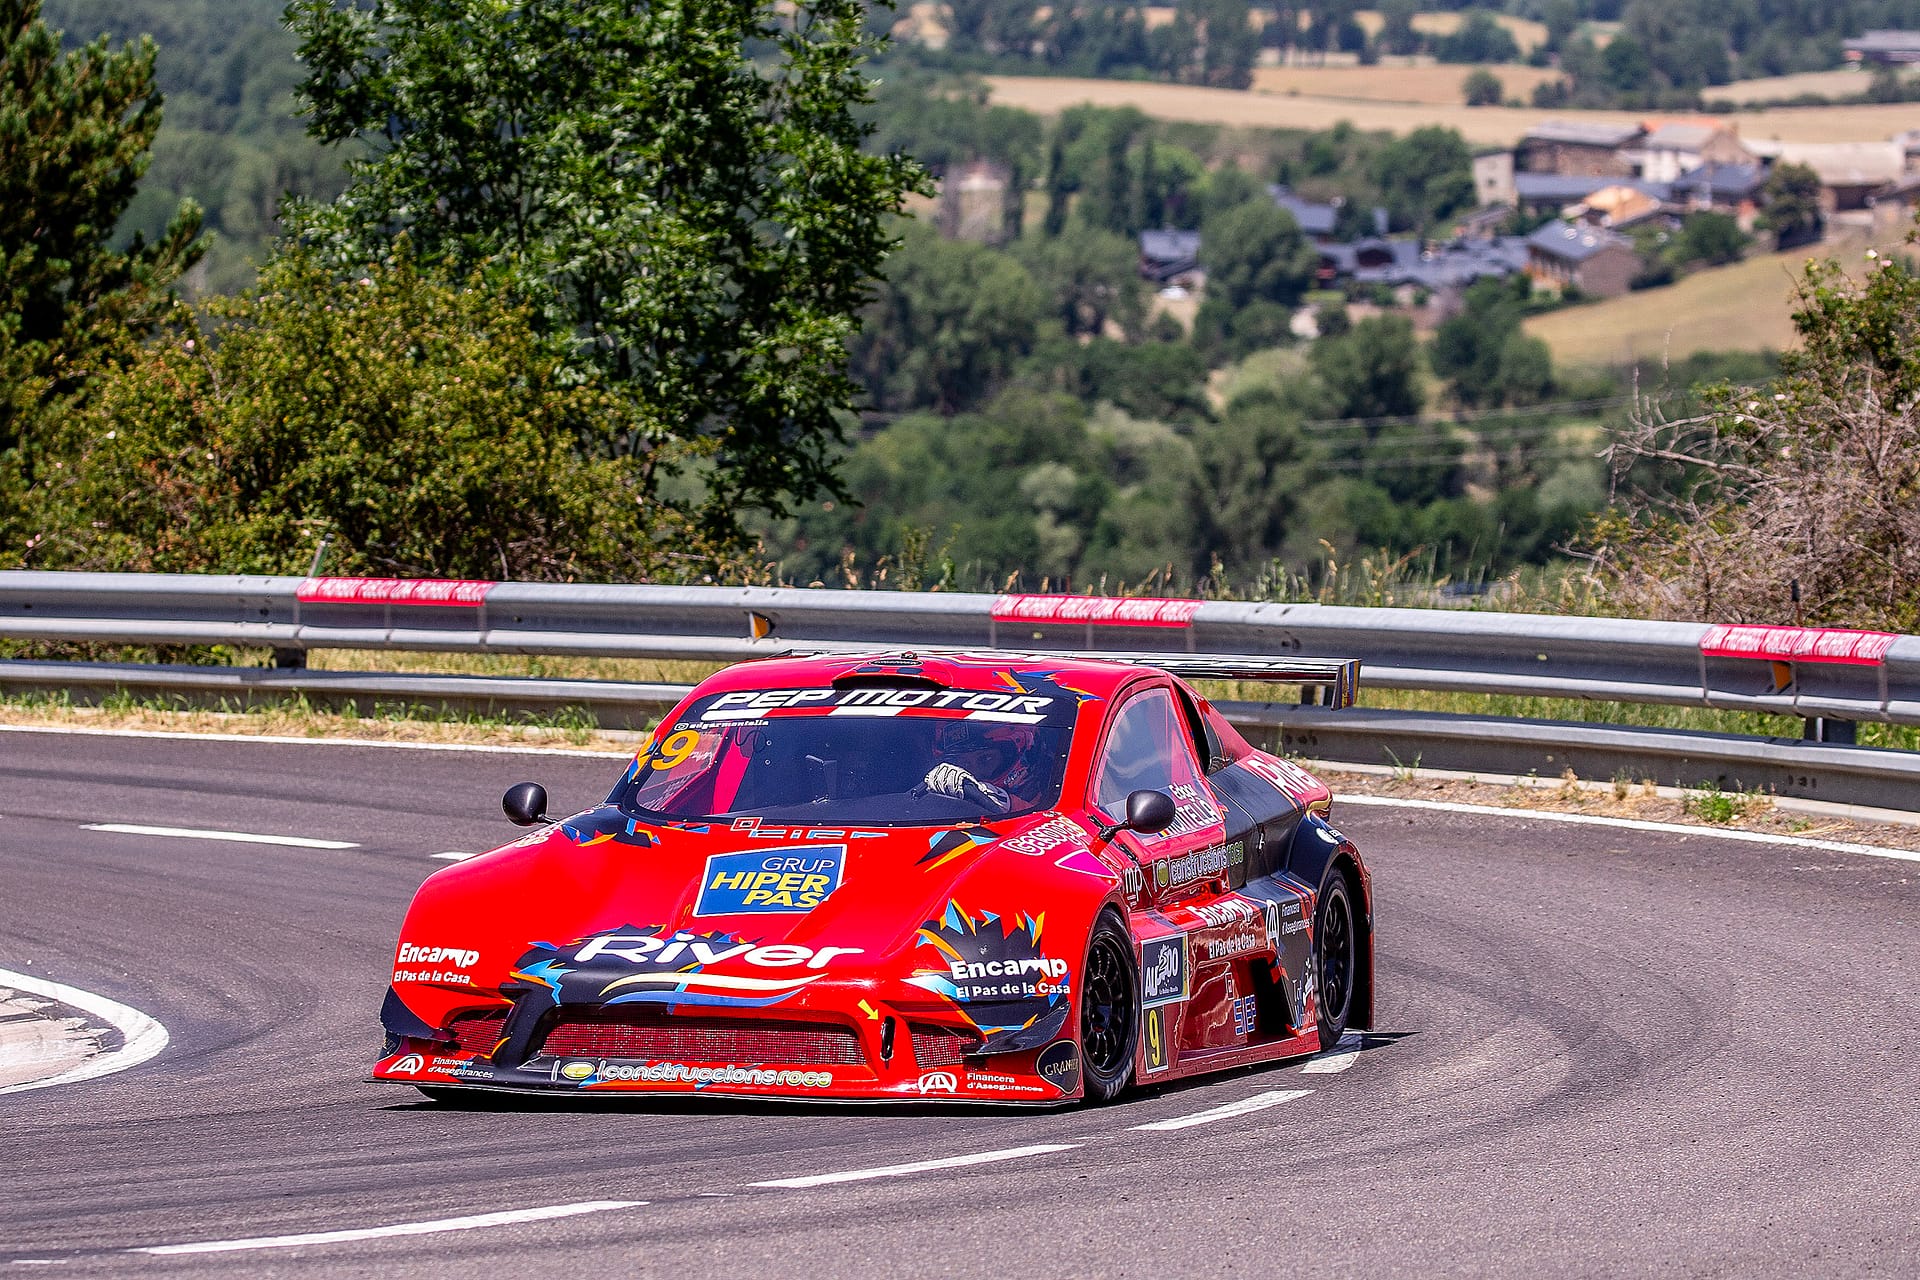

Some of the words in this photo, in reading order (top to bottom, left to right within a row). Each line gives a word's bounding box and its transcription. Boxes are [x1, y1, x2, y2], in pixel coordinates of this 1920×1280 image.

[706, 688, 836, 711] PEP
[839, 689, 1054, 713] MOTOR
[651, 729, 700, 771] 9
[761, 857, 835, 873] GRUP
[709, 871, 831, 893] HIPER
[742, 889, 825, 909] PAS
[397, 942, 480, 968] Encamp
[573, 933, 865, 969] River
[394, 970, 402, 982] El
[402, 970, 417, 982] Pas
[418, 970, 430, 982] de
[431, 970, 442, 982] la
[443, 971, 471, 984] Casa
[949, 958, 1068, 980] Encamp
[955, 985, 970, 998] El
[972, 986, 998, 996] Pas
[1001, 983, 1019, 995] de
[1022, 982, 1035, 994] la
[1038, 983, 1071, 994] Casa
[1148, 1008, 1161, 1067] 9
[432, 1057, 474, 1067] Financera
[966, 1073, 1015, 1084] Financera
